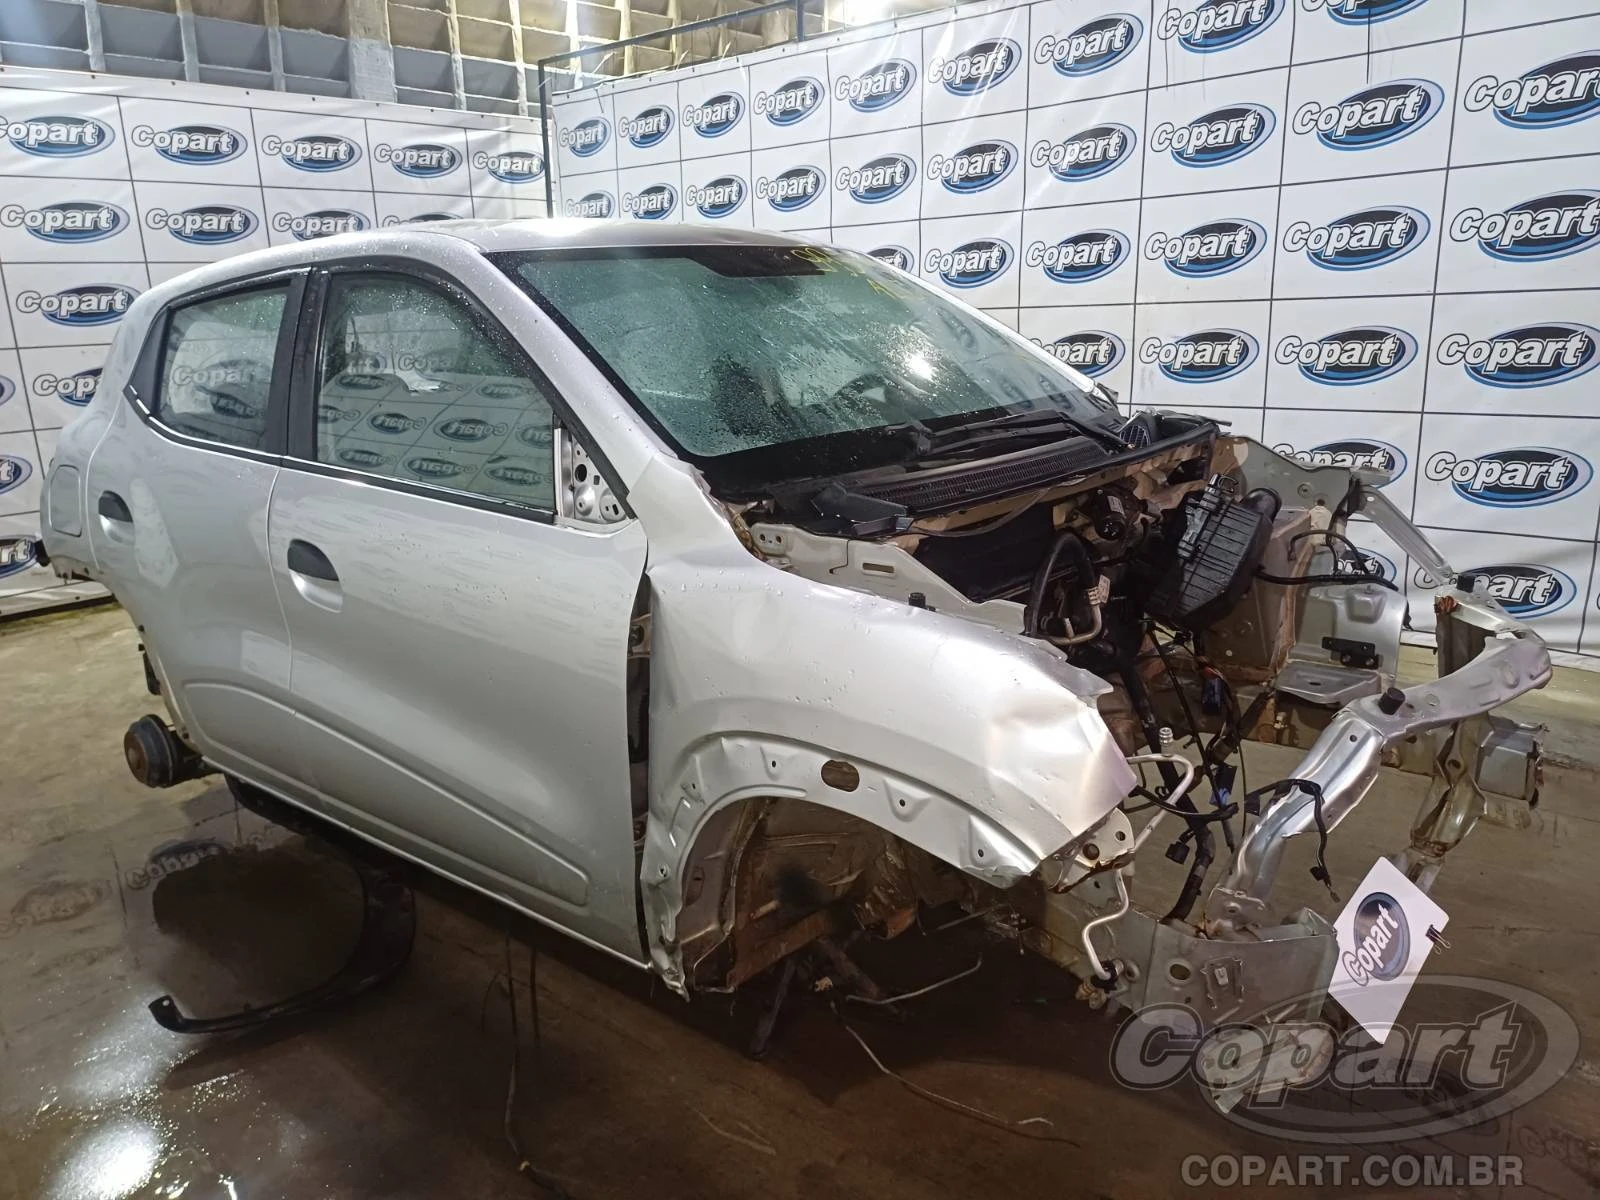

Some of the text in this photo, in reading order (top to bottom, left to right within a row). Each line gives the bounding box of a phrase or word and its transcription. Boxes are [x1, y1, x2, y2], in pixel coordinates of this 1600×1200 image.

[1157, 0, 1269, 44] Copart
[1034, 19, 1131, 65] Copart
[928, 44, 1009, 87] Copart
[753, 83, 816, 118] Copart
[835, 64, 905, 105] Copart
[1464, 66, 1600, 117] Copar
[618, 108, 667, 142] Copart
[682, 97, 738, 130] Copart
[1292, 85, 1427, 139] Copart
[131, 125, 234, 155] Copart
[261, 134, 350, 163] Copart
[559, 122, 605, 147] Copart
[1150, 109, 1261, 153] Copart
[374, 144, 452, 169] Copart
[472, 151, 543, 174] Copart
[927, 145, 1008, 184] Copart
[1030, 129, 1124, 172] Copart
[755, 170, 817, 201] Copart
[835, 159, 906, 194] Copart
[565, 196, 610, 217] Copart
[623, 185, 672, 214] Copart
[685, 180, 741, 213] Copart
[1, 204, 114, 234] Copart
[145, 208, 246, 236] Copart
[272, 211, 359, 237] Copart
[1283, 211, 1414, 256] Copart
[1450, 197, 1600, 248] Copart
[924, 244, 1006, 279] Copart
[1026, 233, 1117, 273] Copart
[1145, 224, 1255, 268] Copart
[16, 289, 128, 318] Copart
[1140, 330, 1248, 373] Copart
[1275, 328, 1404, 373] Copart
[1437, 330, 1588, 375] Copart
[33, 374, 103, 399] Cop
[1425, 451, 1572, 492] Copart
[1342, 903, 1398, 986] Copart
